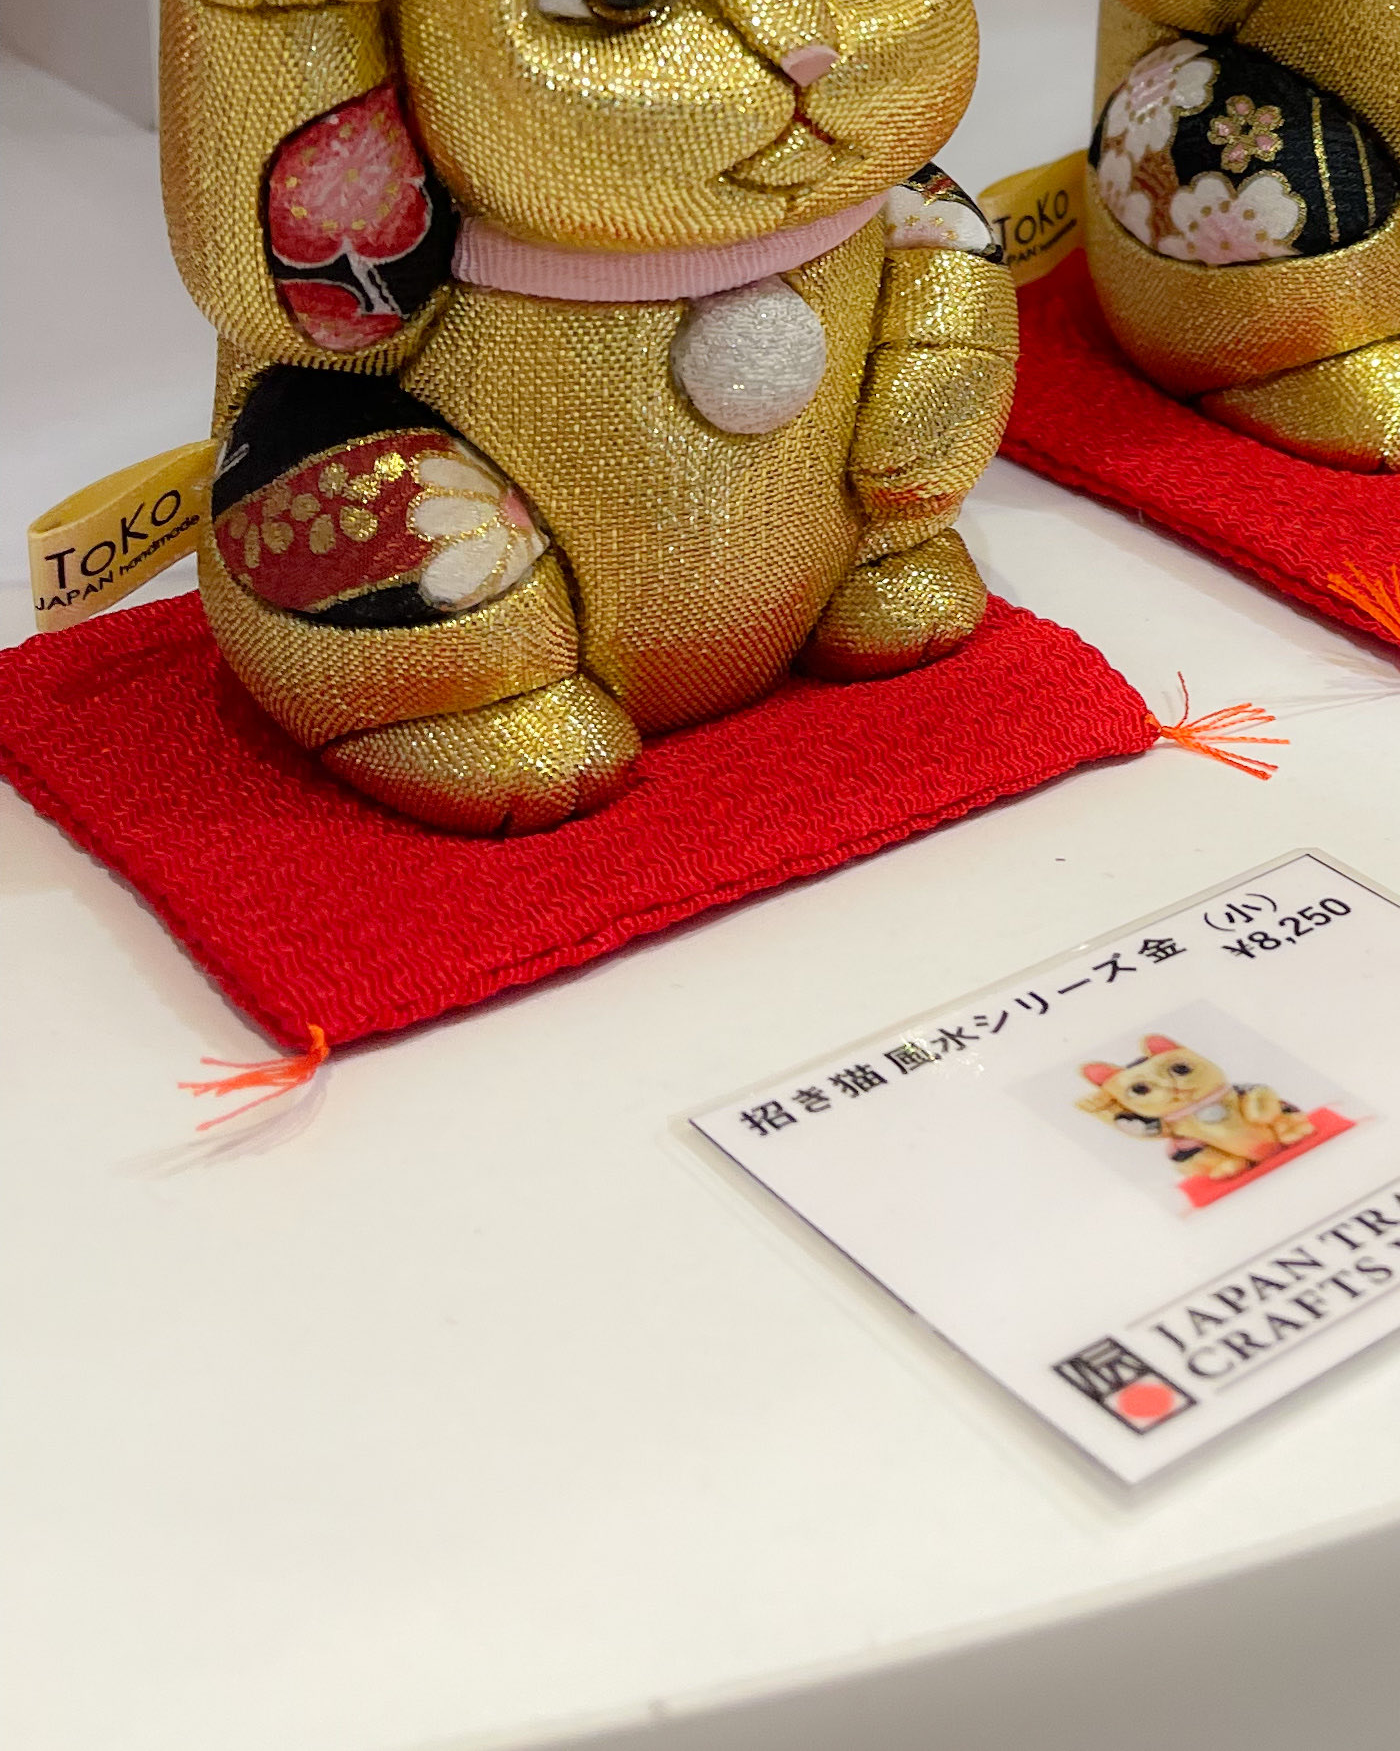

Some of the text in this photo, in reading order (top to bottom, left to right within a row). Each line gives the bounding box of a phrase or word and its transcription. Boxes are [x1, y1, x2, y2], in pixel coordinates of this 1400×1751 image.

[992, 189, 1070, 251] TOKO
[44, 489, 182, 590] TOKO
[34, 569, 114, 611] JAPAN
[1221, 897, 1352, 960] ¥8,250
[1151, 1247, 1324, 1352] JAPAN
[1186, 1255, 1394, 1380] CRAFTS
